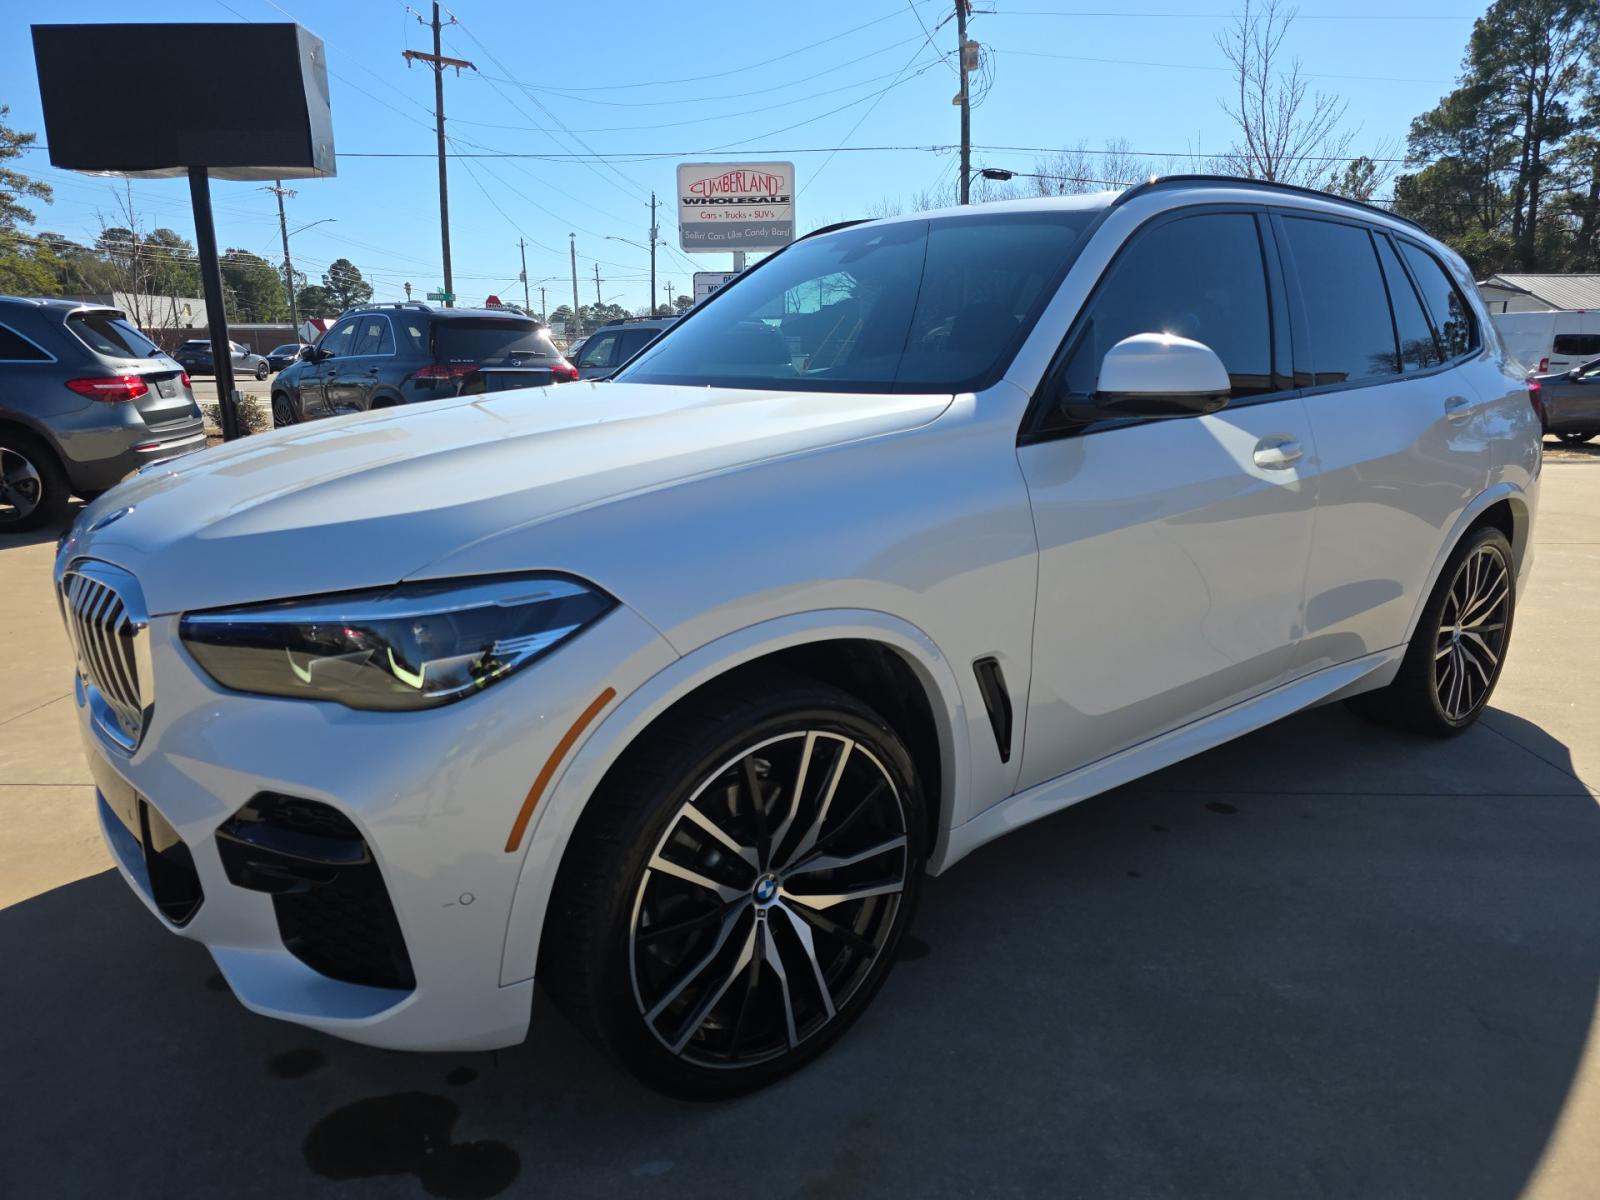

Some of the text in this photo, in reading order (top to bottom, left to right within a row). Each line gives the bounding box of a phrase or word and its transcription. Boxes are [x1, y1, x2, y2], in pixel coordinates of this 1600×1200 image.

[690, 171, 778, 197] CUMBERLAND
[682, 197, 790, 205] WHOLESALE
[700, 210, 775, 219] Cars Trucks SUV's
[708, 232, 724, 240] Cars
[728, 231, 741, 240] Like
[745, 228, 768, 237] Candy
